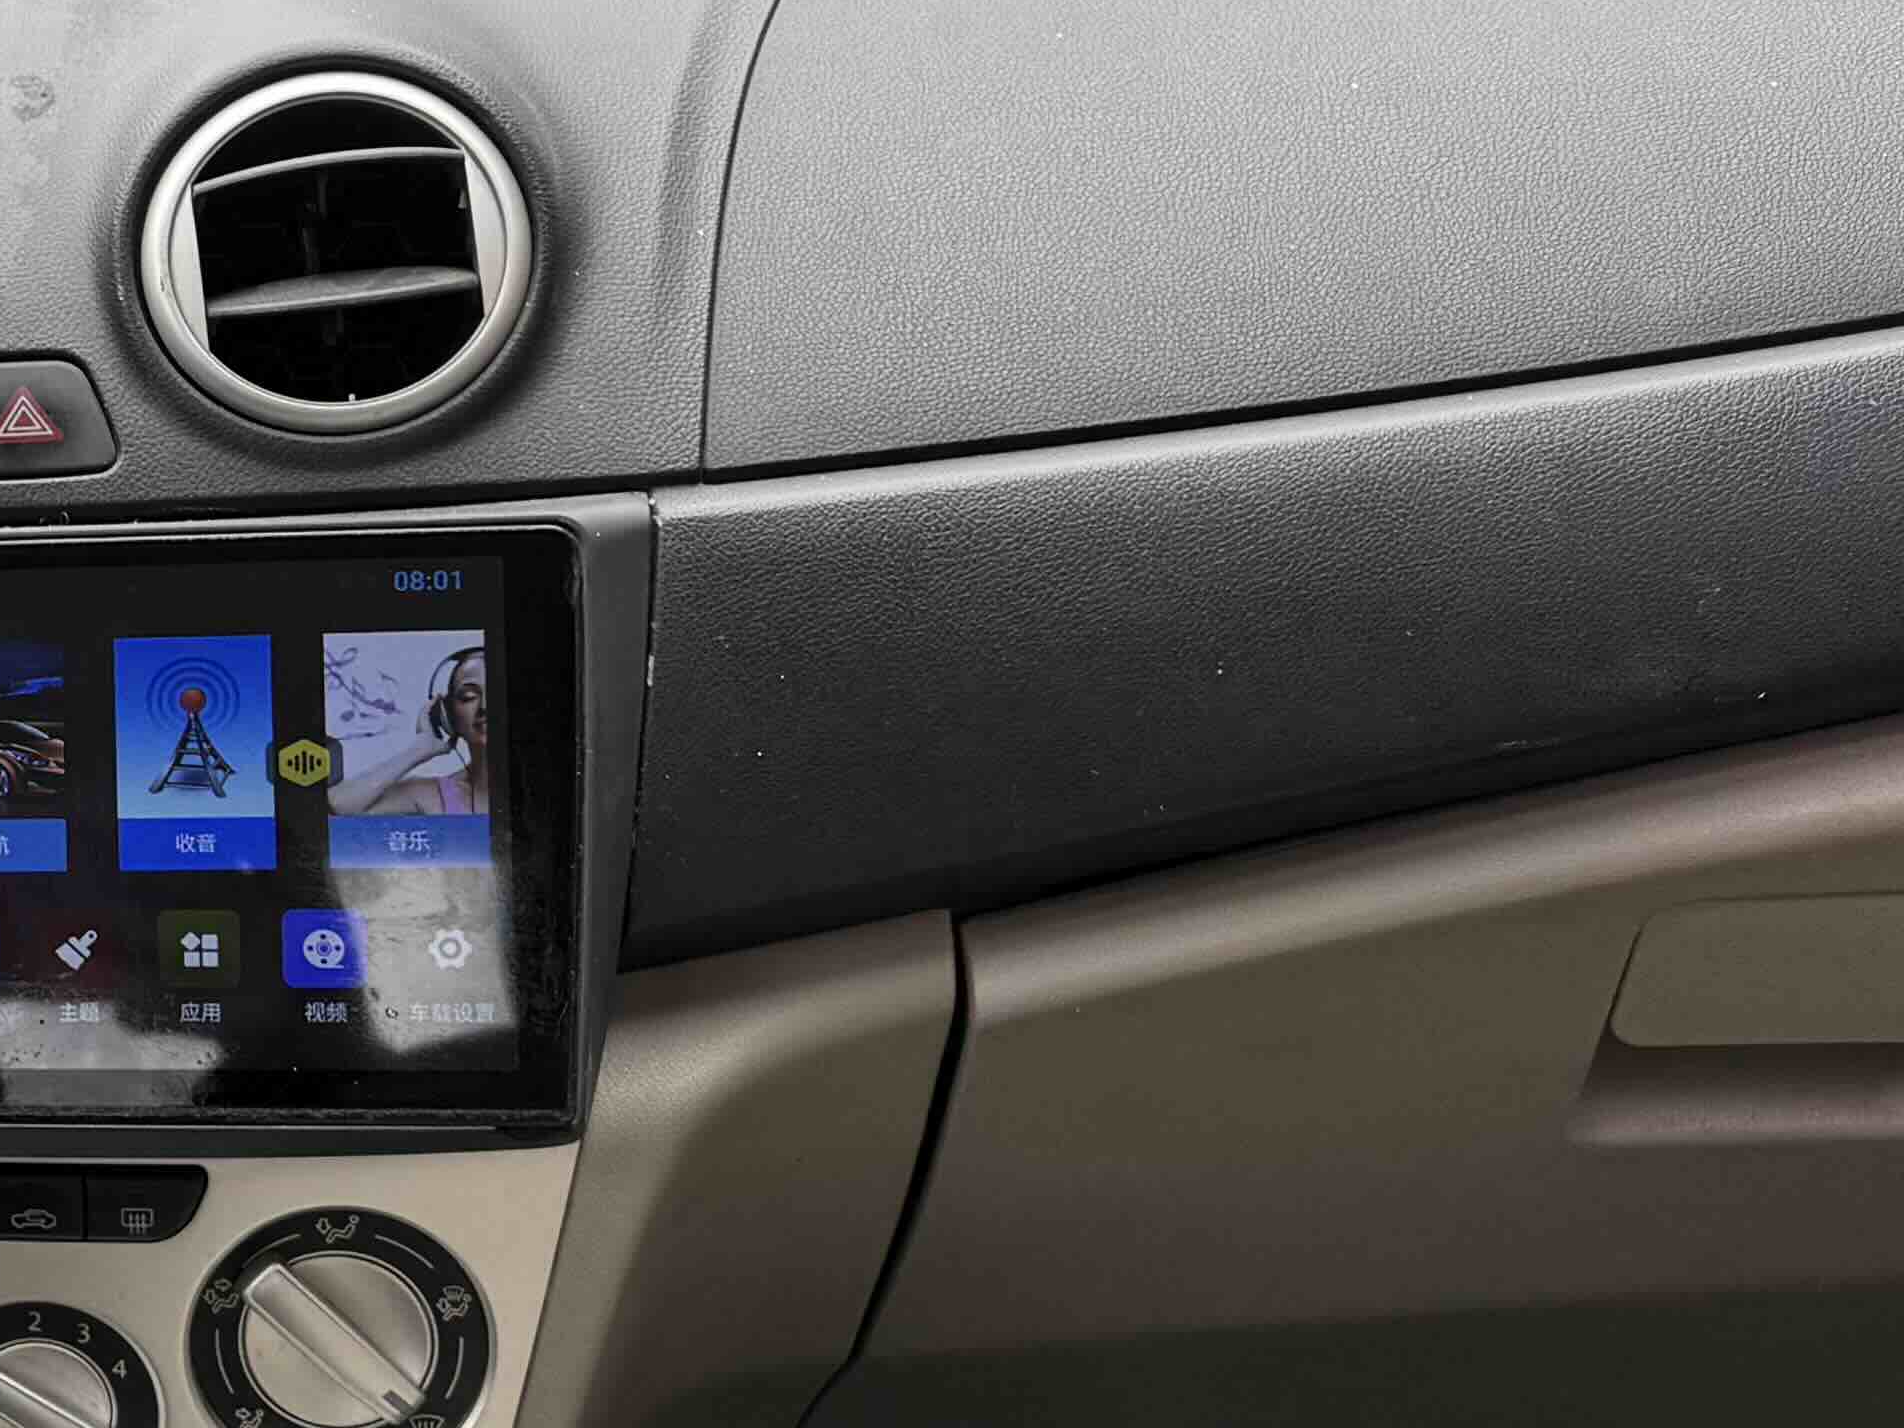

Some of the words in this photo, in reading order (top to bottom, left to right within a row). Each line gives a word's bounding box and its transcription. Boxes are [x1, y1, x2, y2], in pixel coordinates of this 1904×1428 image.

[393, 570, 462, 591] 08:01
[175, 833, 216, 855] 收音
[387, 830, 431, 854] 音乐
[180, 1002, 222, 1022] 应用
[304, 1002, 348, 1023] 视频
[27, 1311, 41, 1332] 2
[78, 1324, 91, 1344] 3
[112, 1359, 127, 1379] 4
